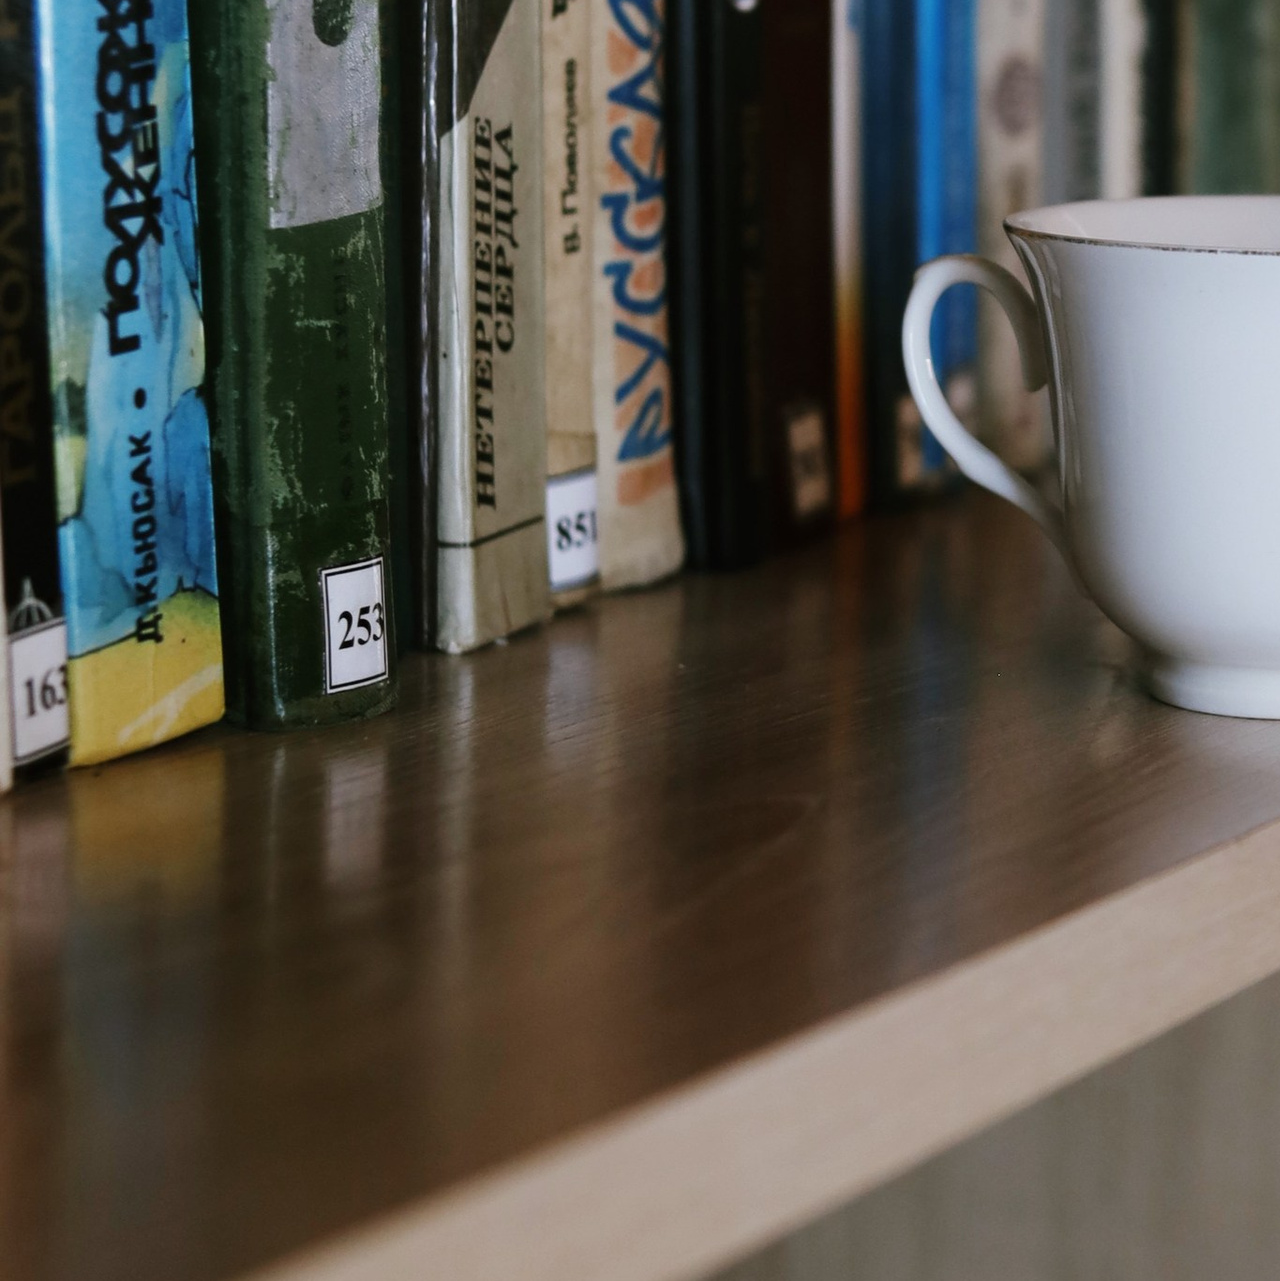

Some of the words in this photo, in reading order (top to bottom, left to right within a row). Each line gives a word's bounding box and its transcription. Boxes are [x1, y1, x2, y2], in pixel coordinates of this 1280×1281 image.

[474, 117, 497, 510] НЕТЕРПЕНИЕ
[494, 122, 519, 354] СЕРДЦА
[337, 602, 385, 650] 253
